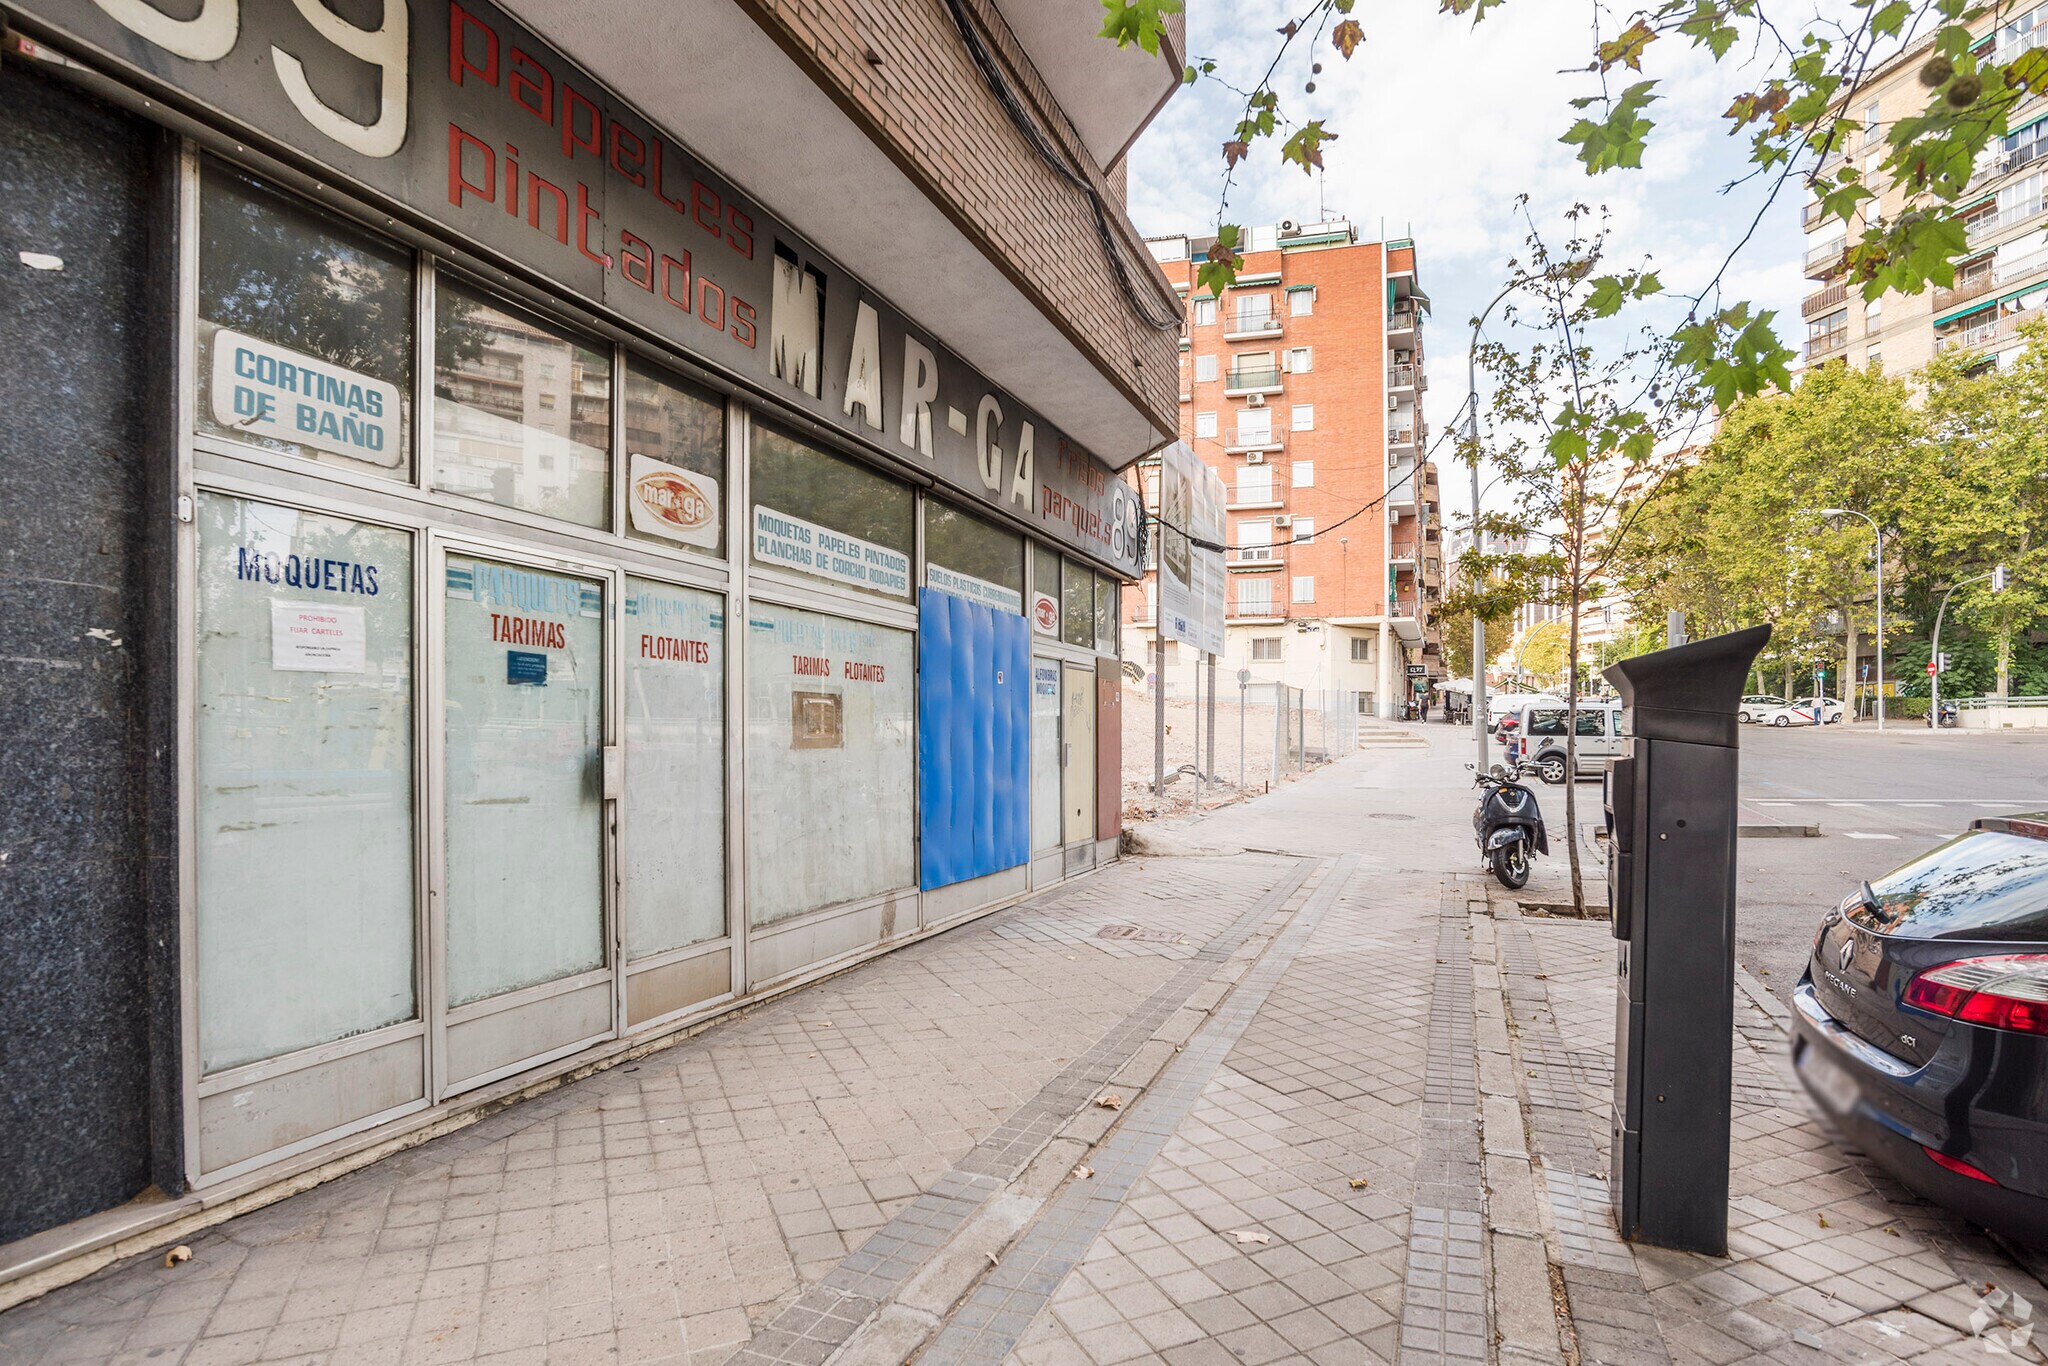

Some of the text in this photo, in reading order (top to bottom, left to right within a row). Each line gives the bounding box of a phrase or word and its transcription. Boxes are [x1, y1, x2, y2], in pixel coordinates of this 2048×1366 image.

[449, 2, 753, 261] papeles
[448, 122, 757, 349] pintados
[235, 347, 384, 418] CORTINAS
[768, 238, 1036, 515] MAR-GA
[234, 385, 384, 452] DE BAÑO
[758, 513, 906, 573] MOQUETAS PAPELES PINTADOS
[1042, 484, 1112, 545] parquets
[1112, 487, 1139, 568] 89
[237, 547, 379, 596] MOQUETAS
[758, 535, 906, 591] PLANCHAS DE CORCHO RODAPIES
[929, 568, 952, 587] SUELOS
[952, 576, 982, 596] PLASTICOS
[298, 614, 337, 624] PROHIBIDO
[311, 627, 344, 637] CARTELES
[491, 613, 565, 649] TARIMAS
[641, 634, 708, 664] FLOTANTES
[792, 655, 885, 683] TARIMAS FLOTANTES
